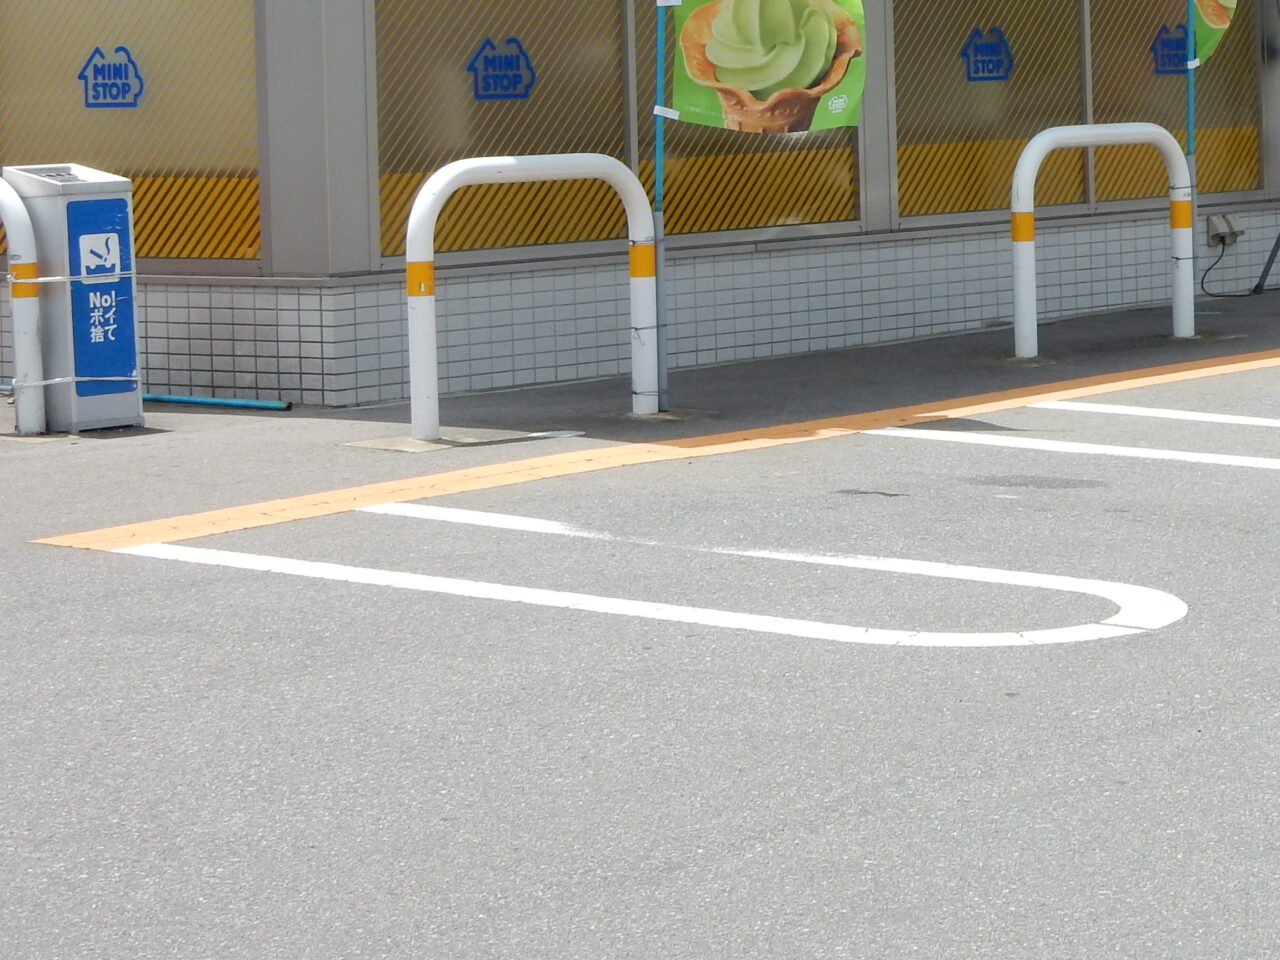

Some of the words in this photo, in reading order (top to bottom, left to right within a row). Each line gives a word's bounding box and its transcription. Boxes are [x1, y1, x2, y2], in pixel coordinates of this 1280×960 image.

[974, 42, 1001, 59] MINI
[93, 62, 128, 83] MINI
[482, 54, 521, 74] MINI
[973, 59, 1004, 76] STOP
[91, 82, 132, 103] STOP
[481, 74, 523, 94] STOP
[89, 290, 116, 309] No!
[89, 309, 117, 325] ポイ
[89, 325, 118, 343] 捨て
